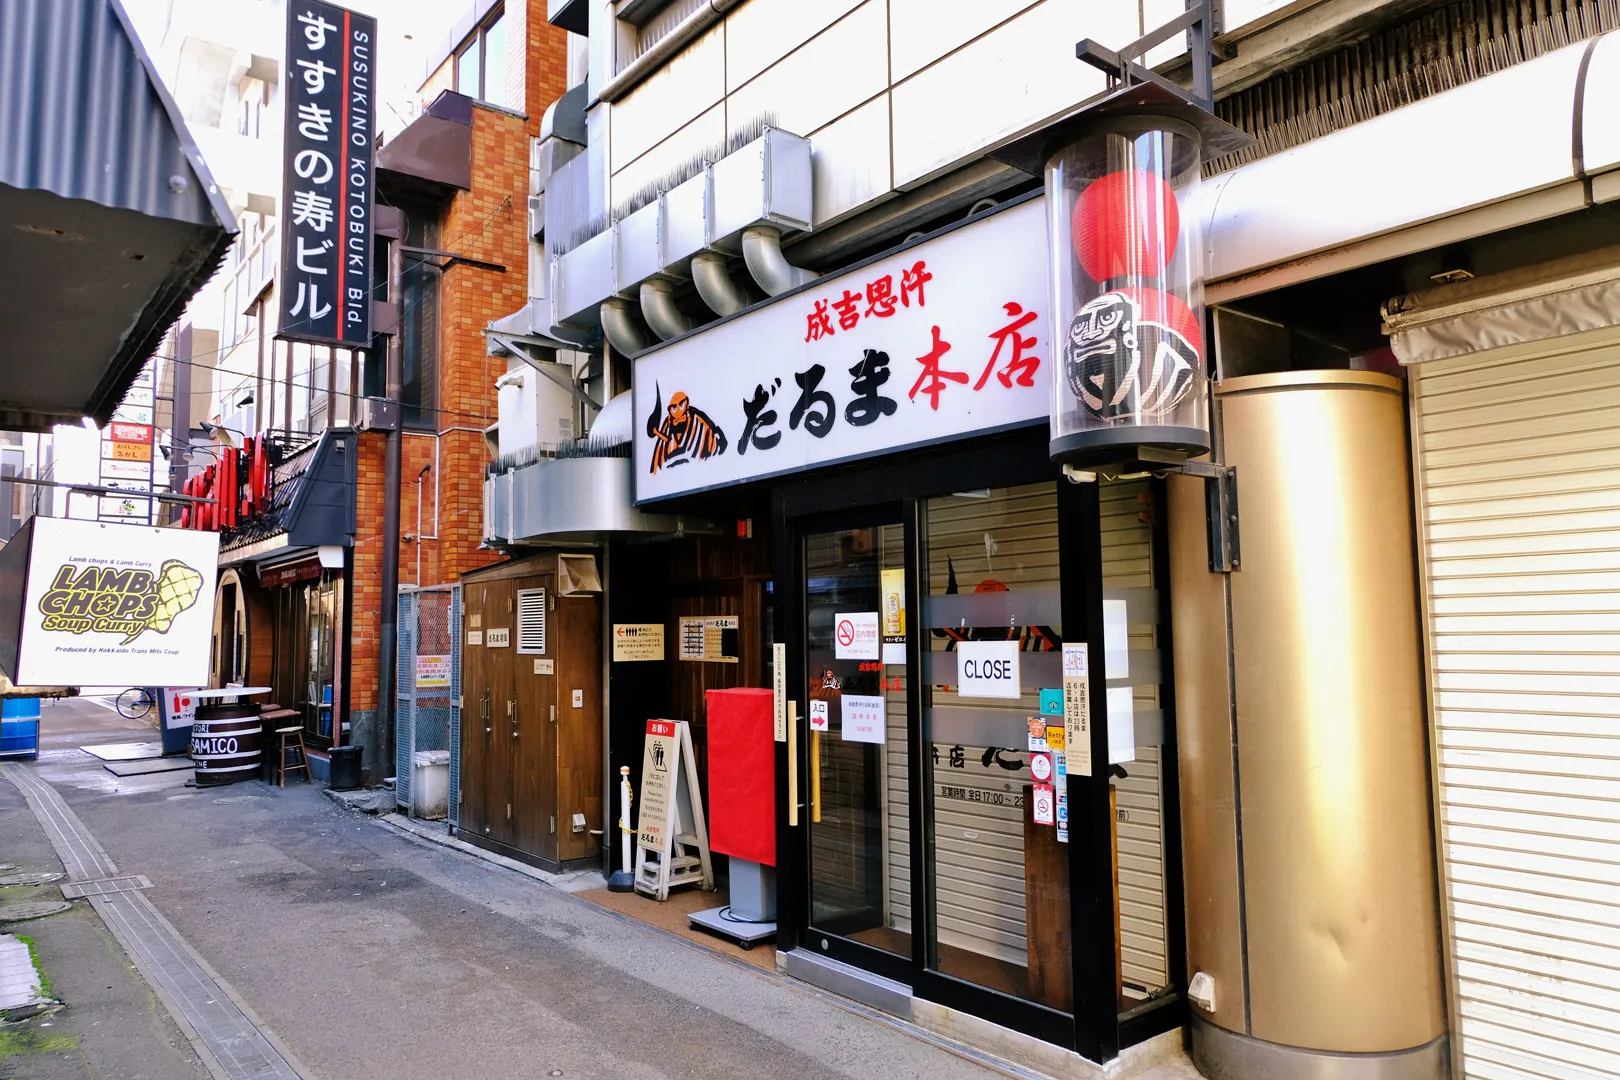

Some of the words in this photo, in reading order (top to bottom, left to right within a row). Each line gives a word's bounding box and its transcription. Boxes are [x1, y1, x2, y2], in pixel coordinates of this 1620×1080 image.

[351, 30, 368, 146] SUSUKINO
[289, 10, 337, 321] すすきの寿ビル
[349, 158, 366, 276] KOTOBUKI
[347, 287, 363, 328] Bld.
[804, 260, 932, 343] 成吉思汗
[88, 557, 108, 566] chops
[51, 565, 153, 595] LAMB
[40, 590, 160, 619] CHOPS
[43, 616, 91, 634] Soup
[94, 618, 145, 635] Curry
[964, 660, 1012, 680] CLOSE
[813, 704, 824, 712] 入口
[652, 723, 668, 733] お願い
[1048, 732, 1065, 741] Retty
[941, 786, 966, 799] 営業時間
[968, 789, 980, 800] 全日
[982, 791, 1004, 804] 17:00
